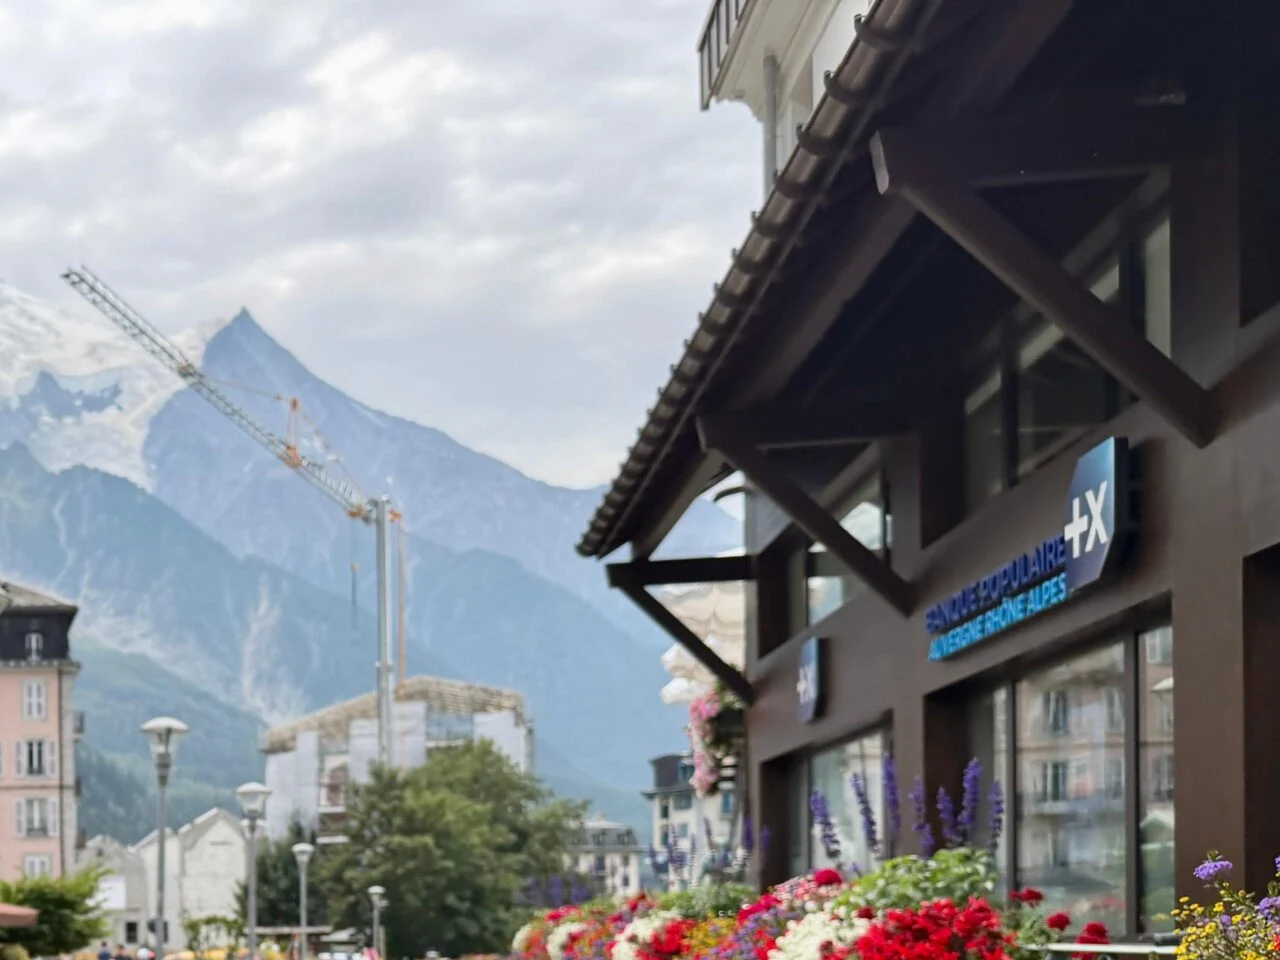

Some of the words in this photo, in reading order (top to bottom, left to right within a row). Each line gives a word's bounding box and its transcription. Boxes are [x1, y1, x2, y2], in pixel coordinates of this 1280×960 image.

[925, 581, 980, 633] BANQUE
[980, 534, 1067, 607] POPULAIRE
[928, 615, 985, 661] AUVERGNE
[1027, 572, 1067, 616] ALPES
